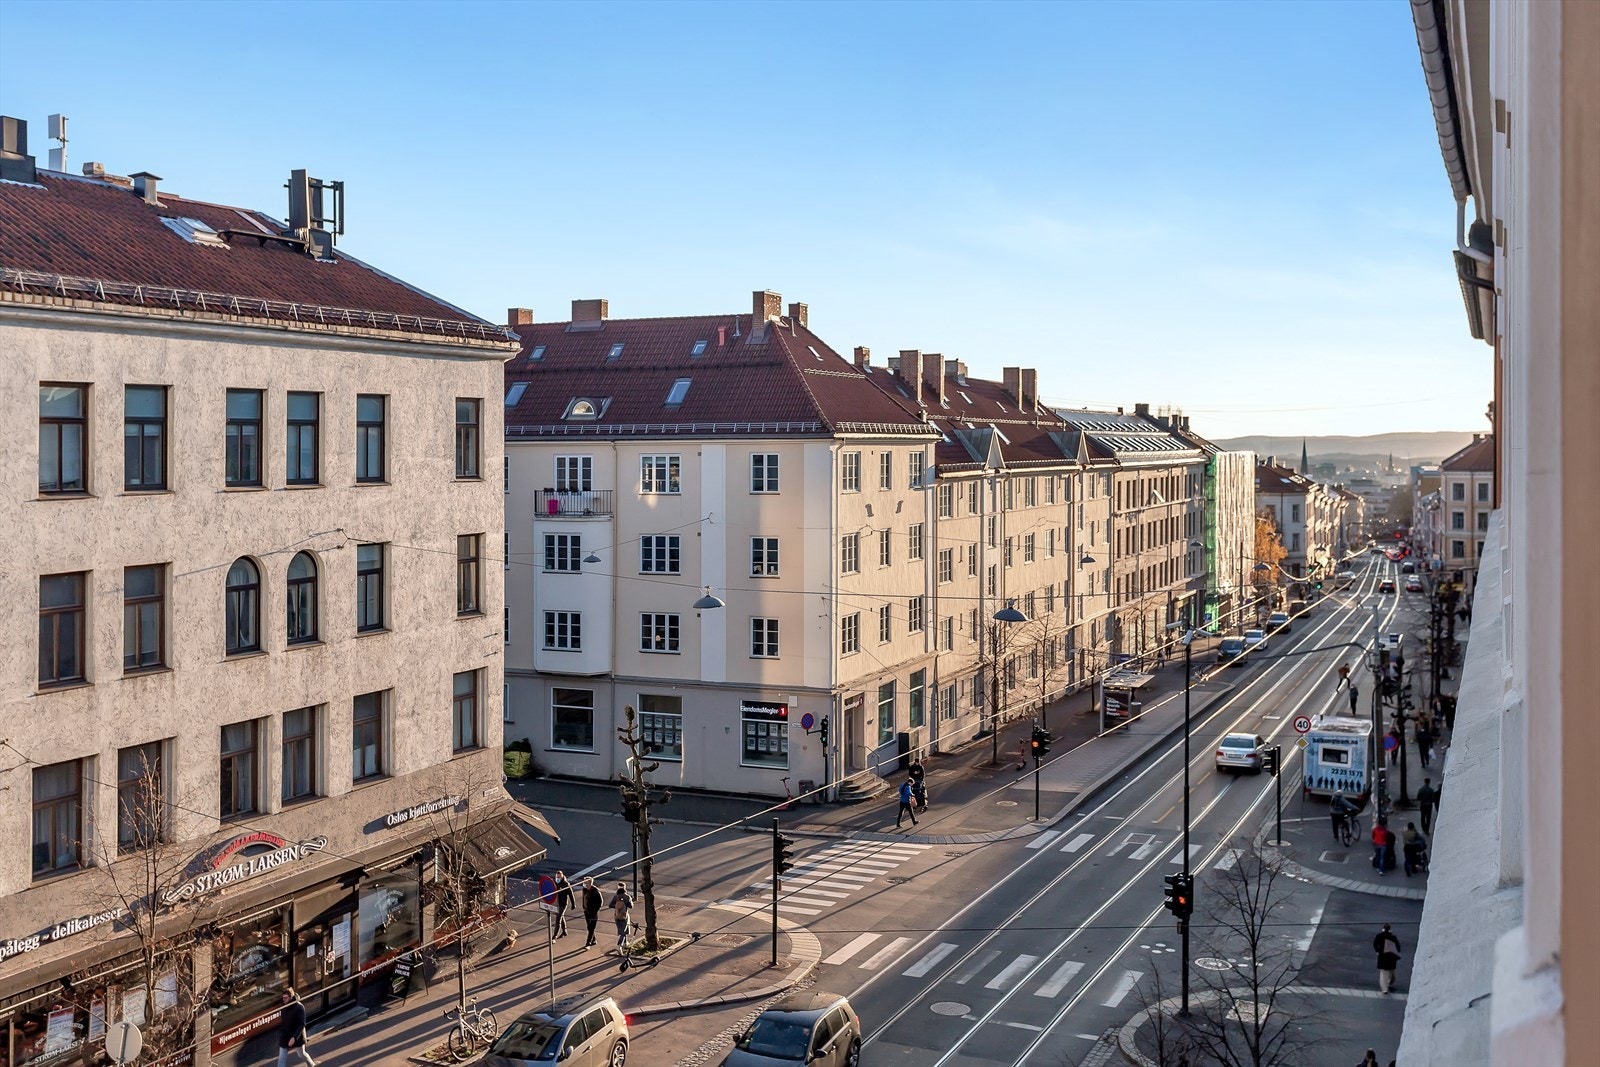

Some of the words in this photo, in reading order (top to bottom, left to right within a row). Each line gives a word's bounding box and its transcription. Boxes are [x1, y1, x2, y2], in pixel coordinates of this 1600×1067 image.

[1297, 721, 1308, 729] 40
[387, 811, 408, 825] Oslos
[196, 844, 299, 893] STRØM-LARSEN
[0, 935, 40, 961] pålegg
[51, 908, 122, 940] delikatesser
[219, 1024, 252, 1044] Hjemmelaget
